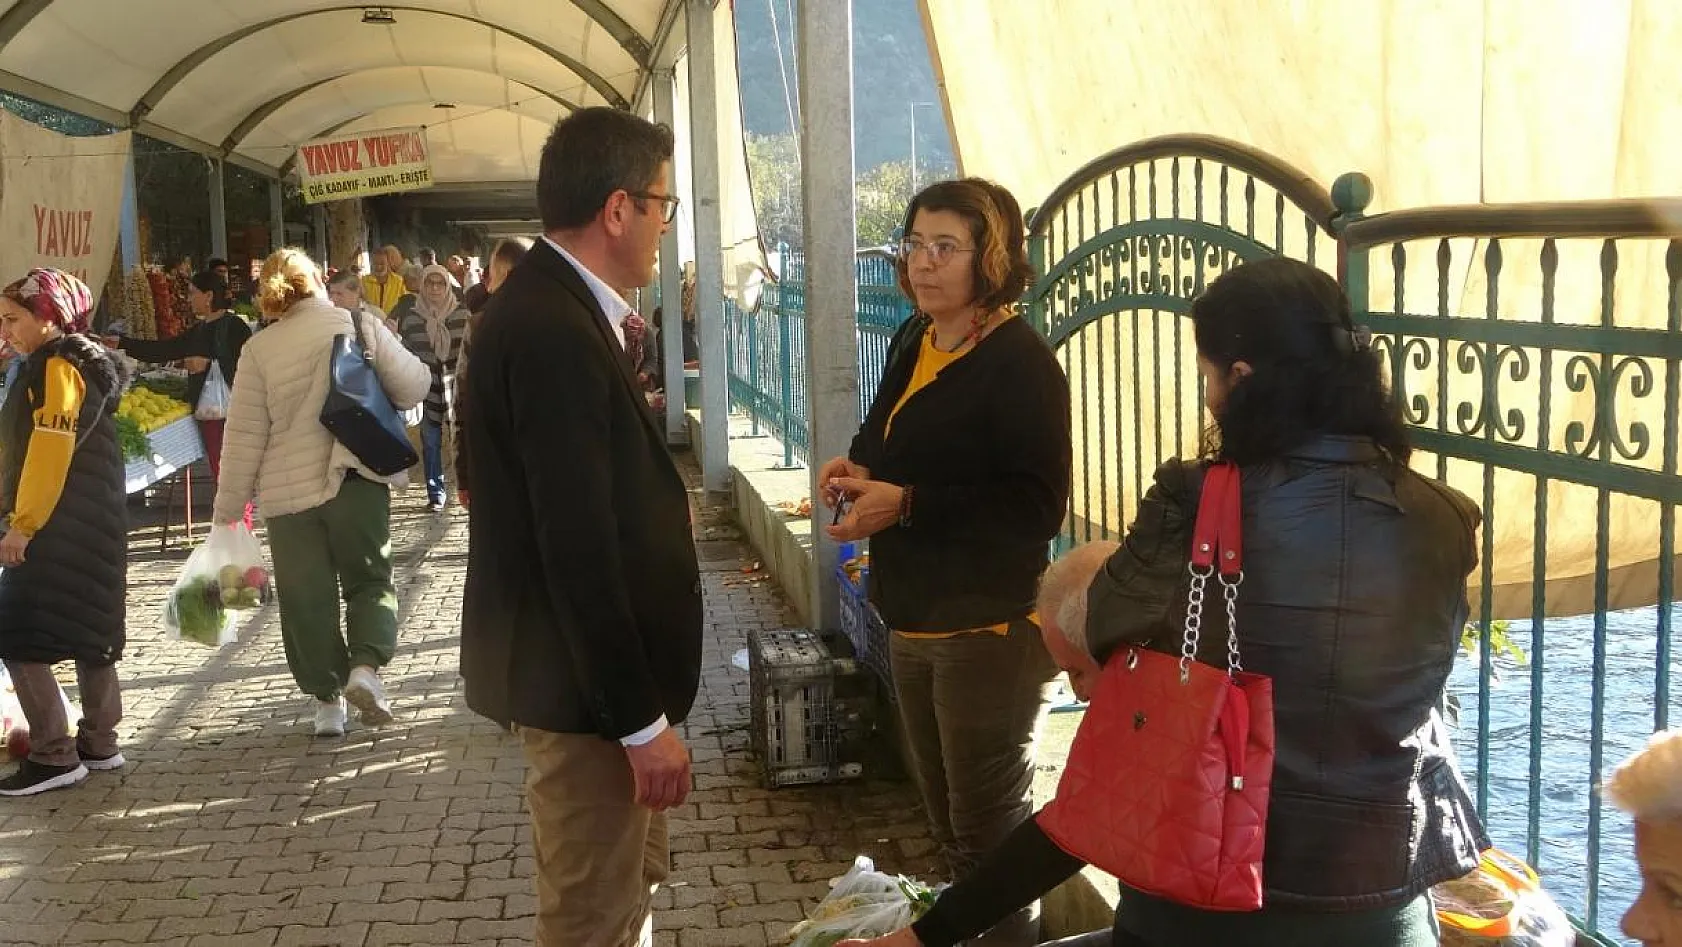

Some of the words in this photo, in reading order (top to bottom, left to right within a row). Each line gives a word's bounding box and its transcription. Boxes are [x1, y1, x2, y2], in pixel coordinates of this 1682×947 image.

[301, 140, 362, 176] YAVUZ
[326, 179, 360, 194] KADAYIF
[33, 203, 92, 257] YAVUZ
